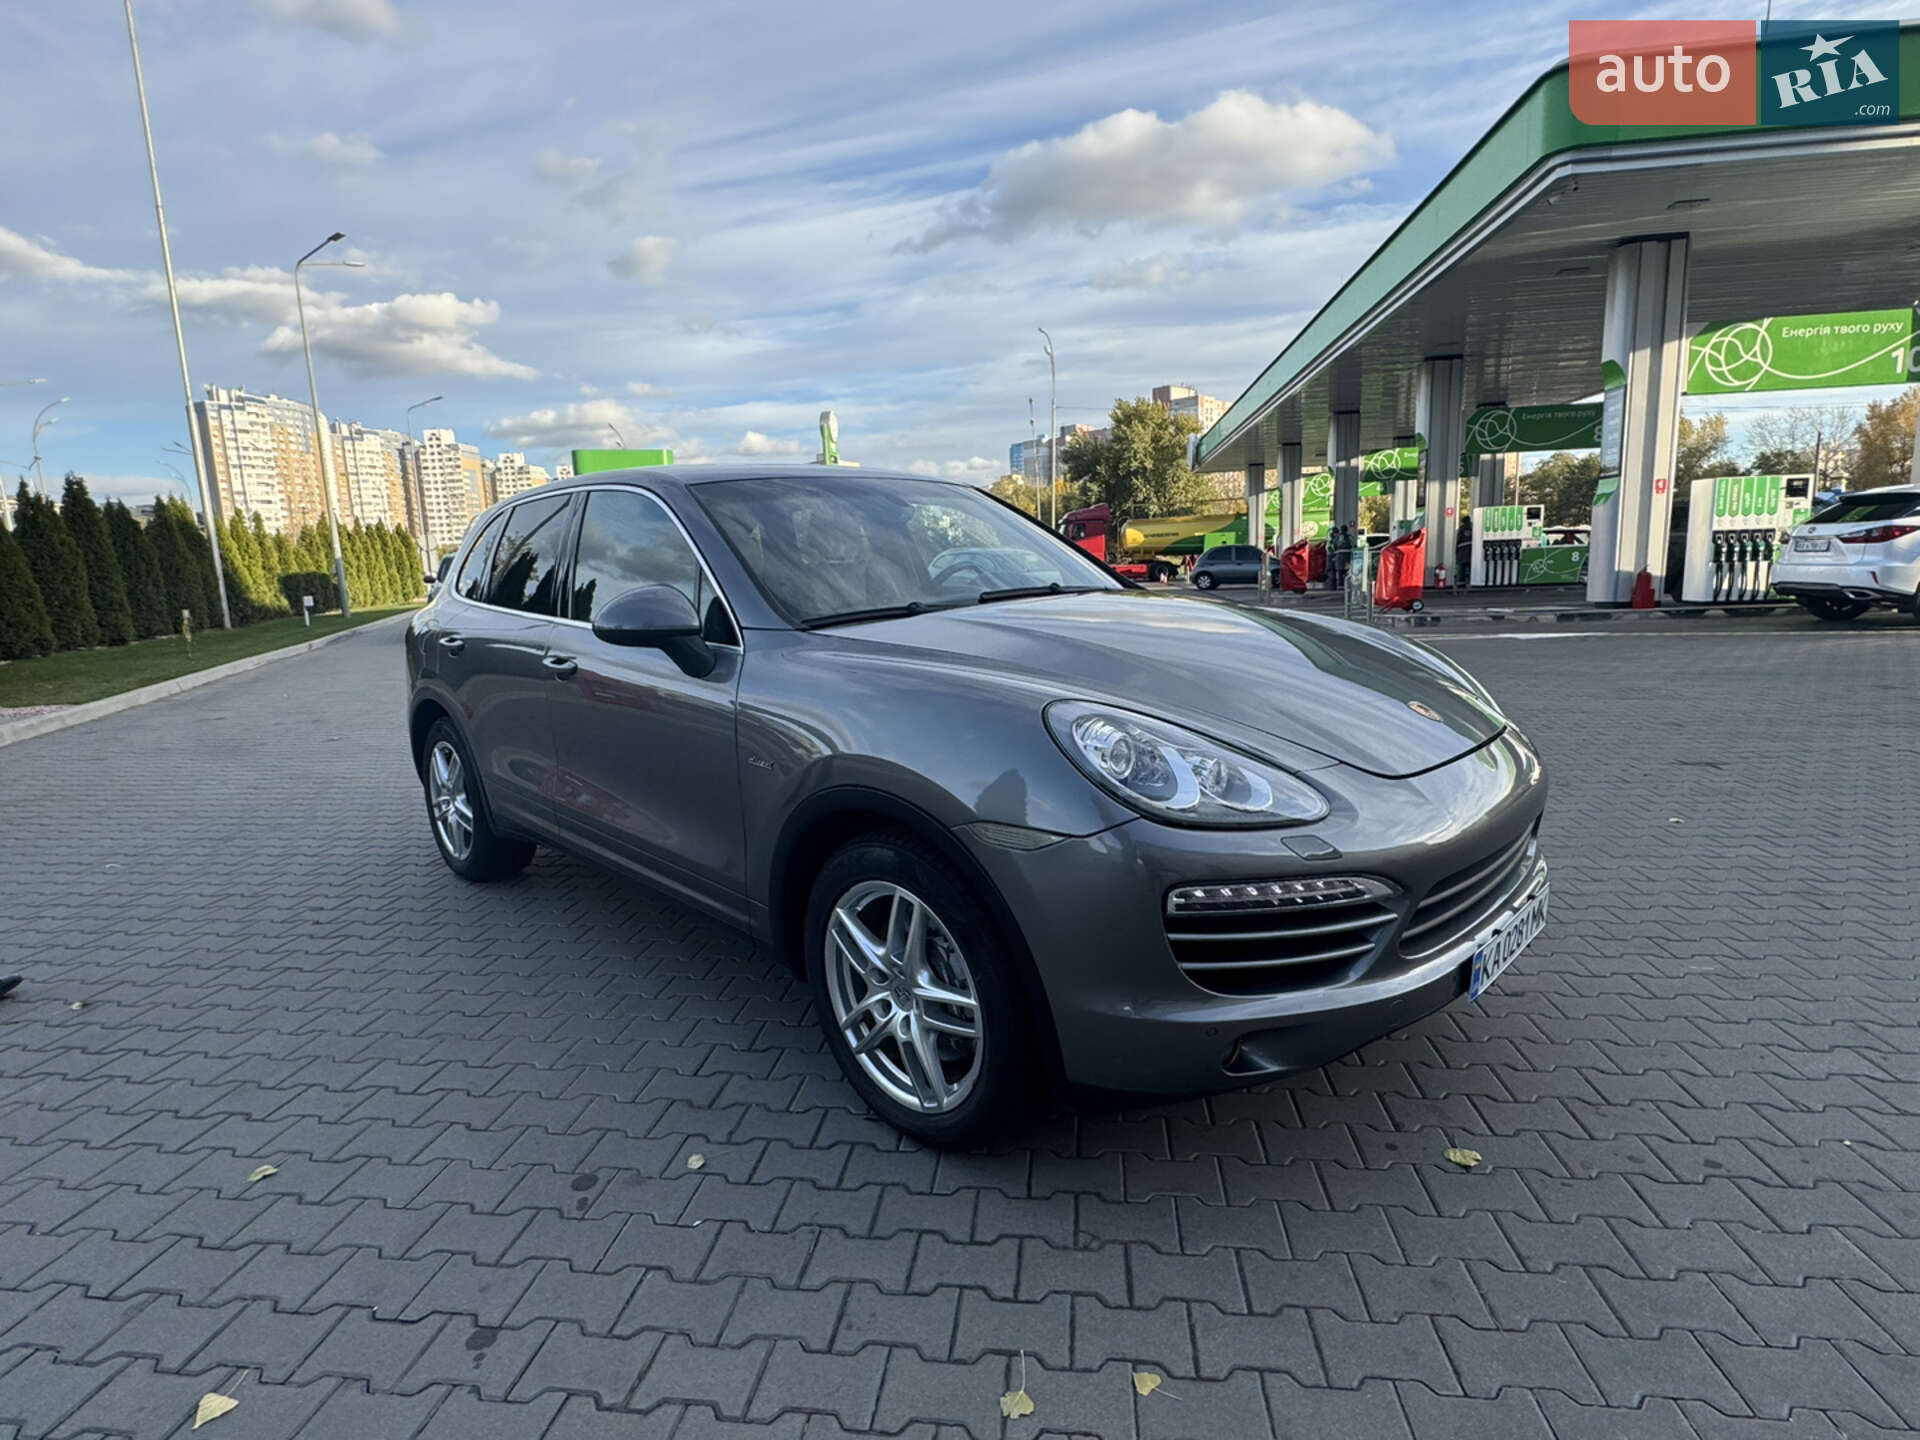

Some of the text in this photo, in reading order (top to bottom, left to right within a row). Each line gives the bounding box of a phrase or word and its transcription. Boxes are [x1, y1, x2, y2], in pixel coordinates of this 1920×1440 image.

[1781, 321, 1904, 338] Енергія твого руху
[1571, 551, 1580, 562] 8
